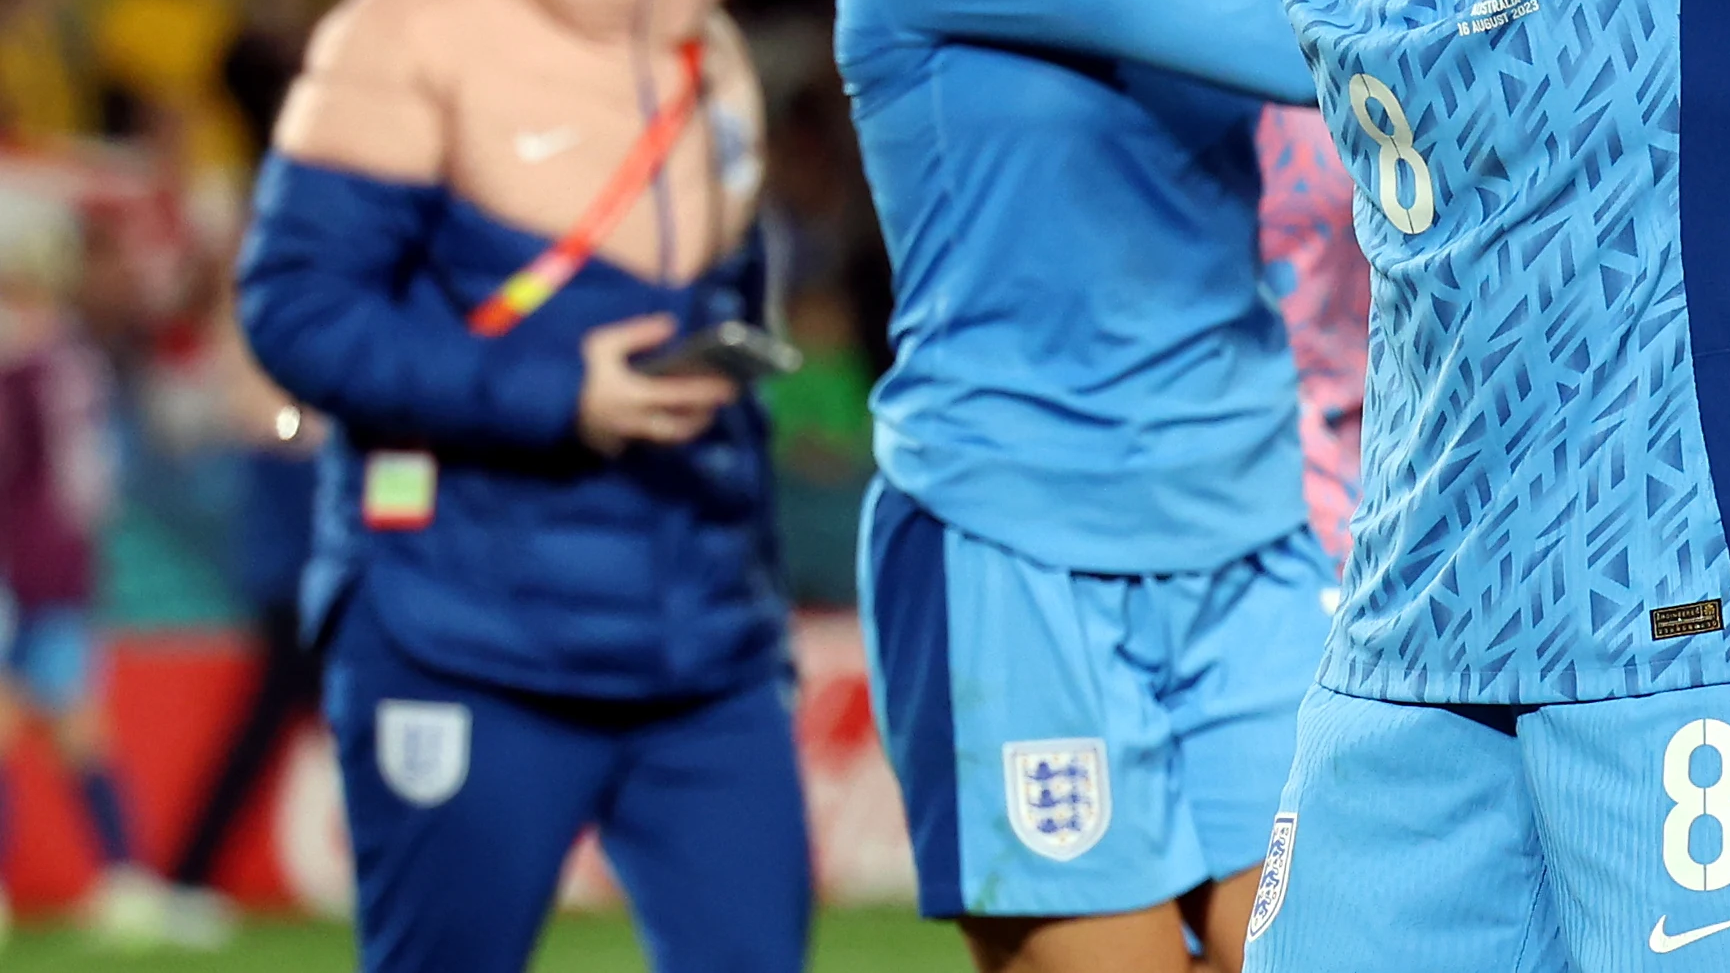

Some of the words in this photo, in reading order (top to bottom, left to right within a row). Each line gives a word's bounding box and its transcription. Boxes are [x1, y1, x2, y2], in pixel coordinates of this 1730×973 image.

[1457, 21, 1470, 36] 16
[1472, 12, 1509, 34] AUGUST
[1349, 73, 1434, 235] 8
